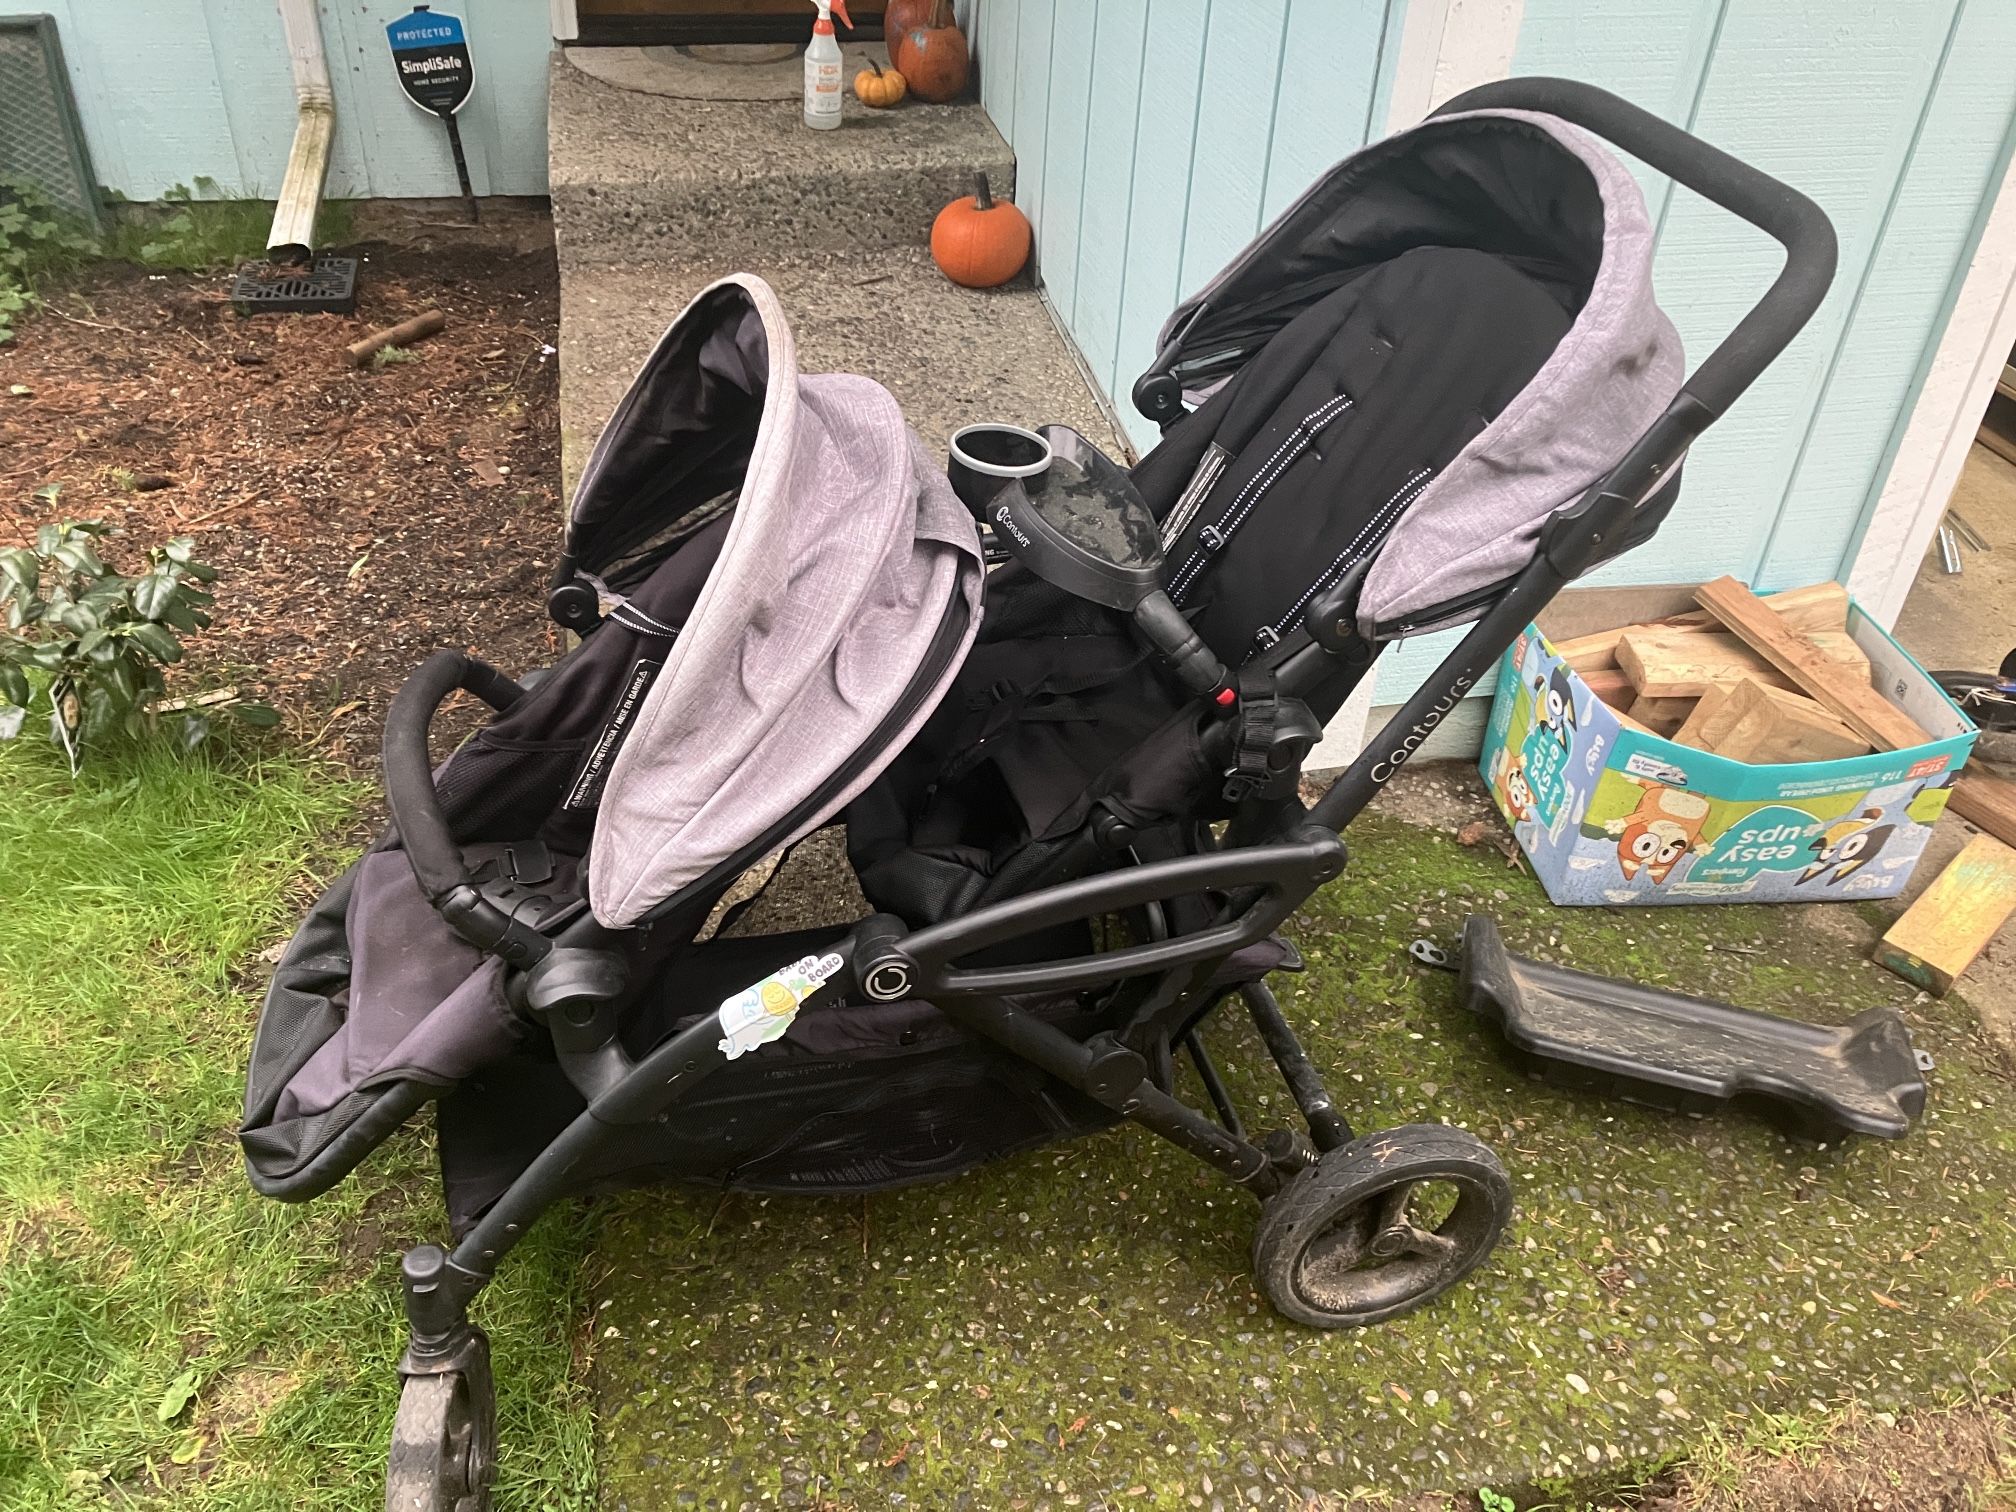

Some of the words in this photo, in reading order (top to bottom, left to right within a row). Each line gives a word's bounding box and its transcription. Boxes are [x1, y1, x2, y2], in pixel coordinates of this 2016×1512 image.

[397, 27, 452, 41] PROTECTED
[401, 56, 462, 74] SimpliSafe
[1002, 514, 1031, 548] Contours
[623, 699, 634, 710] EN
[1370, 676, 1472, 783] Contours
[1530, 735, 1549, 781] ups
[1537, 743, 1560, 802] easy
[1738, 824, 1802, 844] ups
[1717, 844, 1797, 863] easy
[798, 958, 815, 975] ON
[808, 956, 840, 982] BOARD
